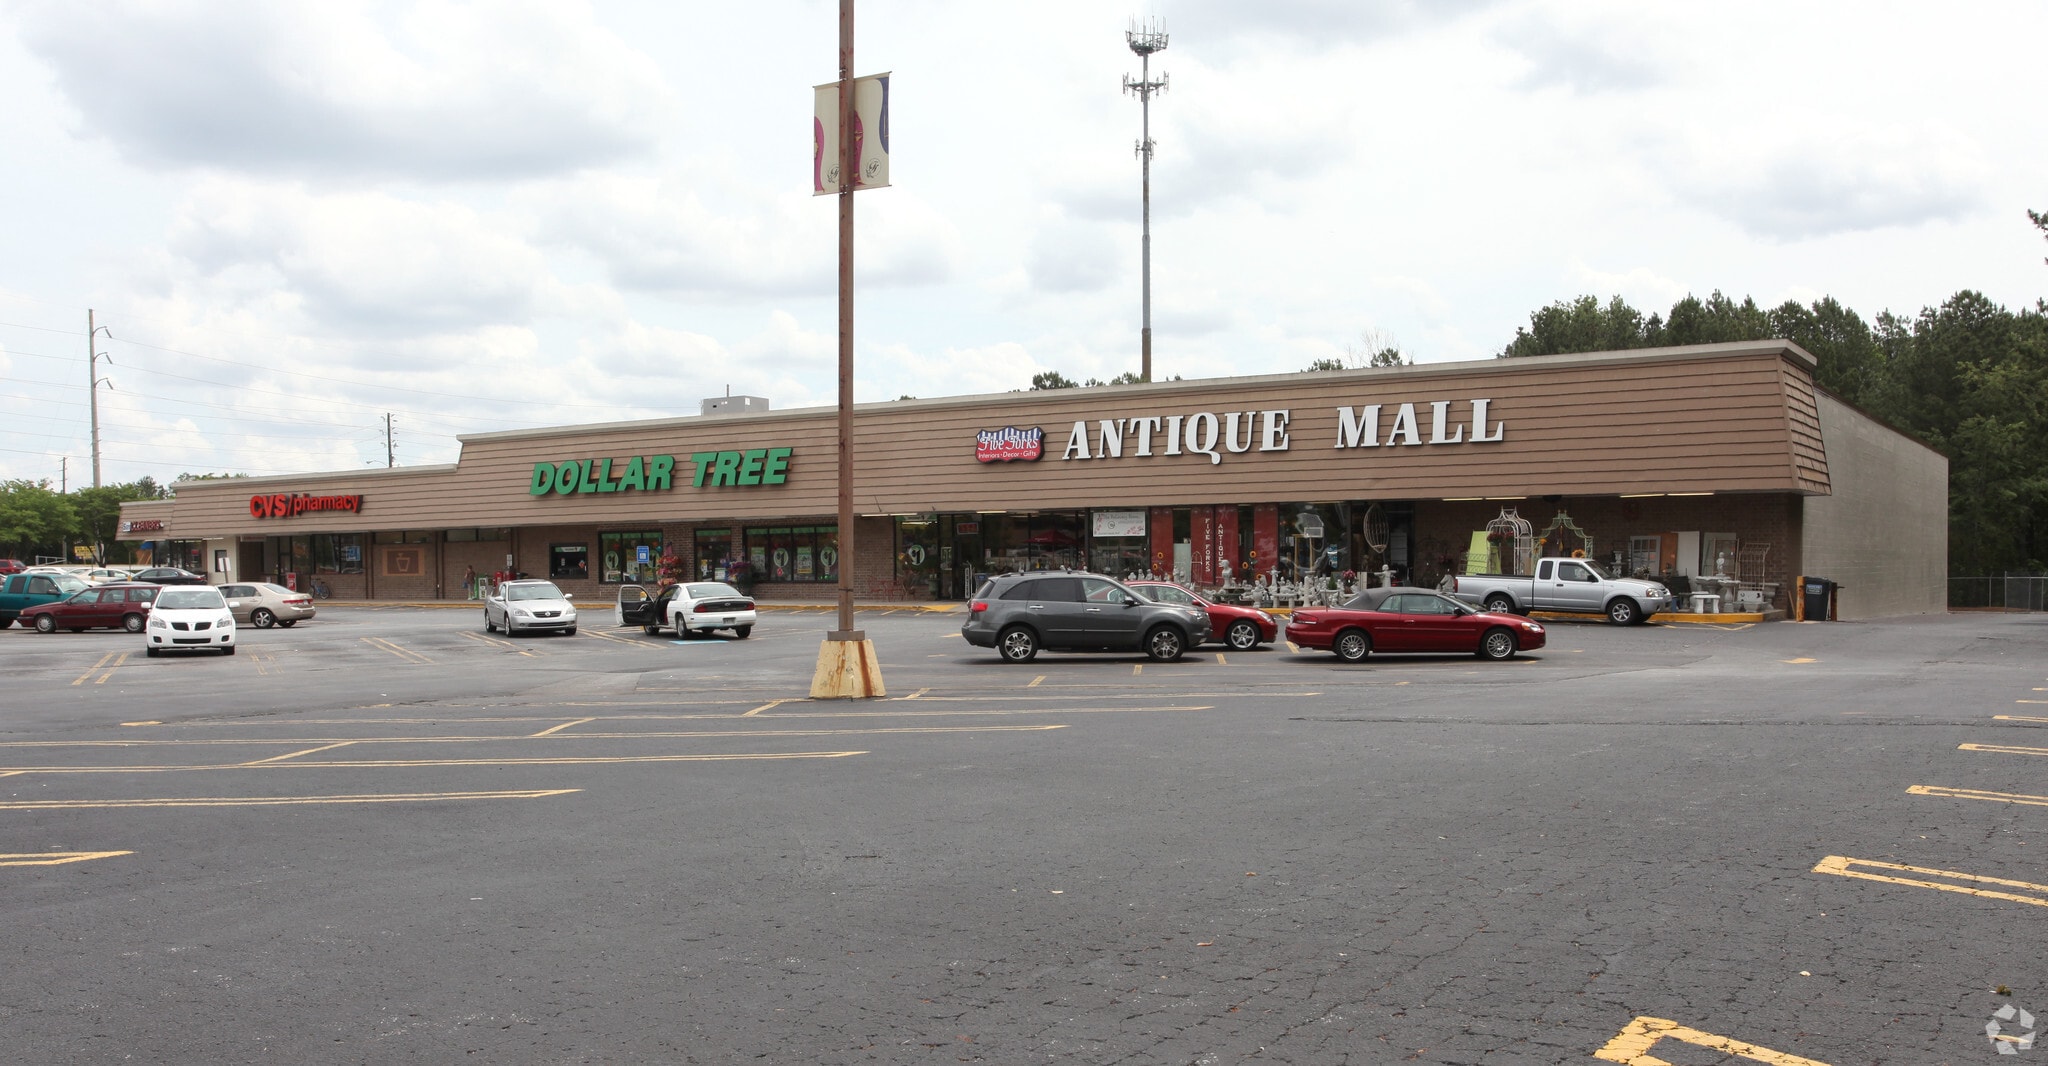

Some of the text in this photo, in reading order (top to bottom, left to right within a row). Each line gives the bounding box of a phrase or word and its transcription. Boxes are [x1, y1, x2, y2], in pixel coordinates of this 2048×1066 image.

[978, 435, 1039, 450] Five Forks
[1062, 398, 1504, 465] ANTIQUE MALL
[1002, 450, 1020, 458] Decor
[529, 447, 793, 496] DOLLAR TREE
[250, 493, 361, 518] CVS/pharmacy
